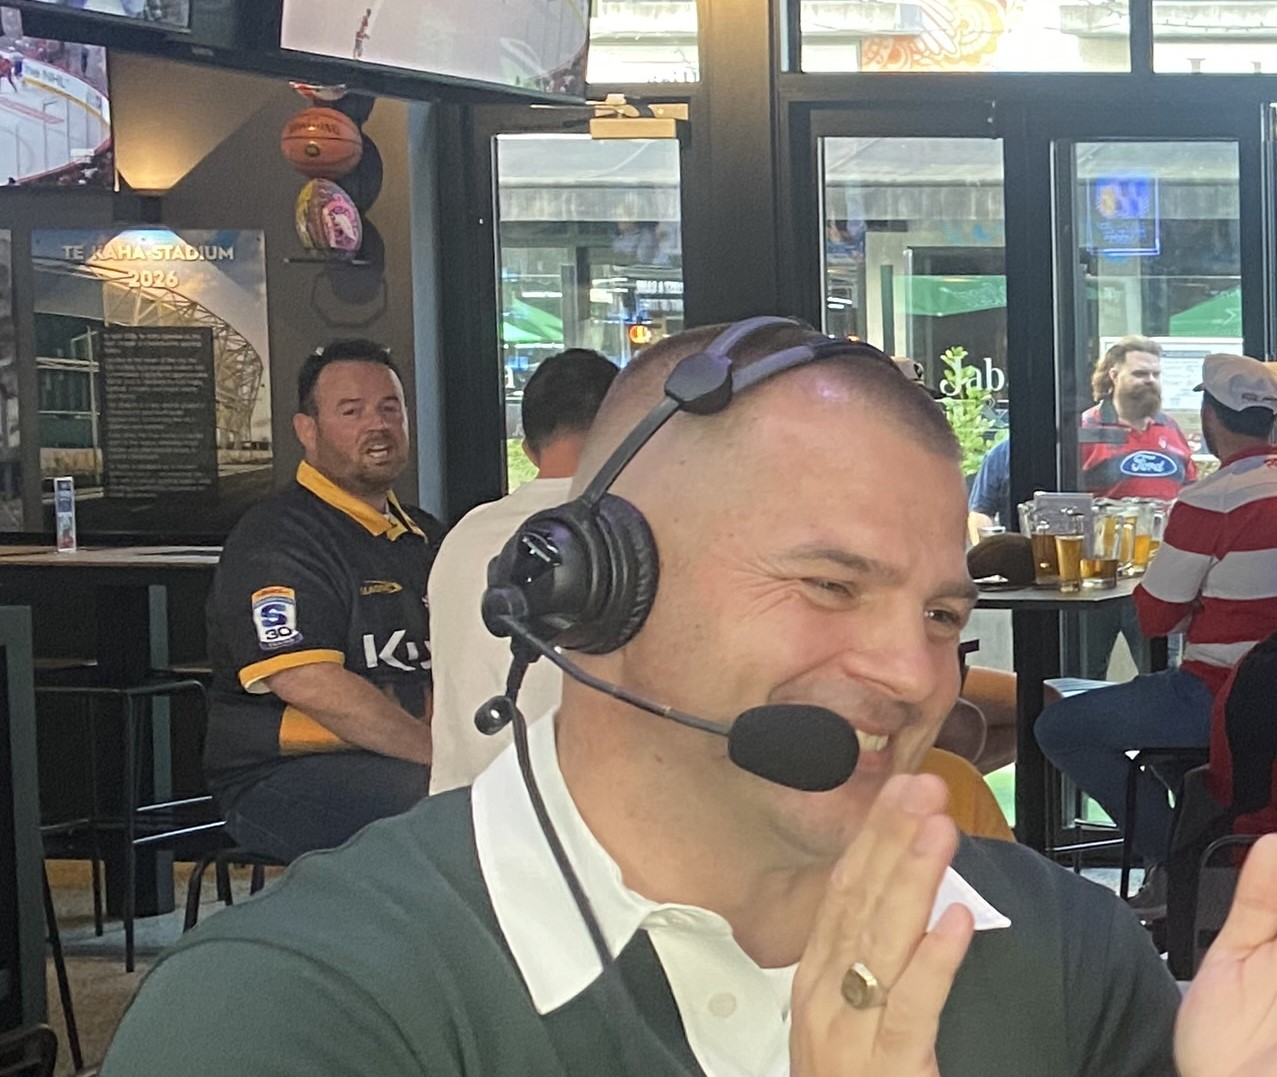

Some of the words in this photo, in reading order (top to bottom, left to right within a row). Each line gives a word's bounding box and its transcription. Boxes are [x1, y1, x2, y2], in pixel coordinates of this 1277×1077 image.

[63, 244, 85, 260] TE
[91, 244, 150, 261] KAHA
[151, 244, 235, 261] STADIUM
[128, 270, 179, 288] 2026
[1130, 453, 1165, 473] Ford
[265, 626, 292, 640] 30
